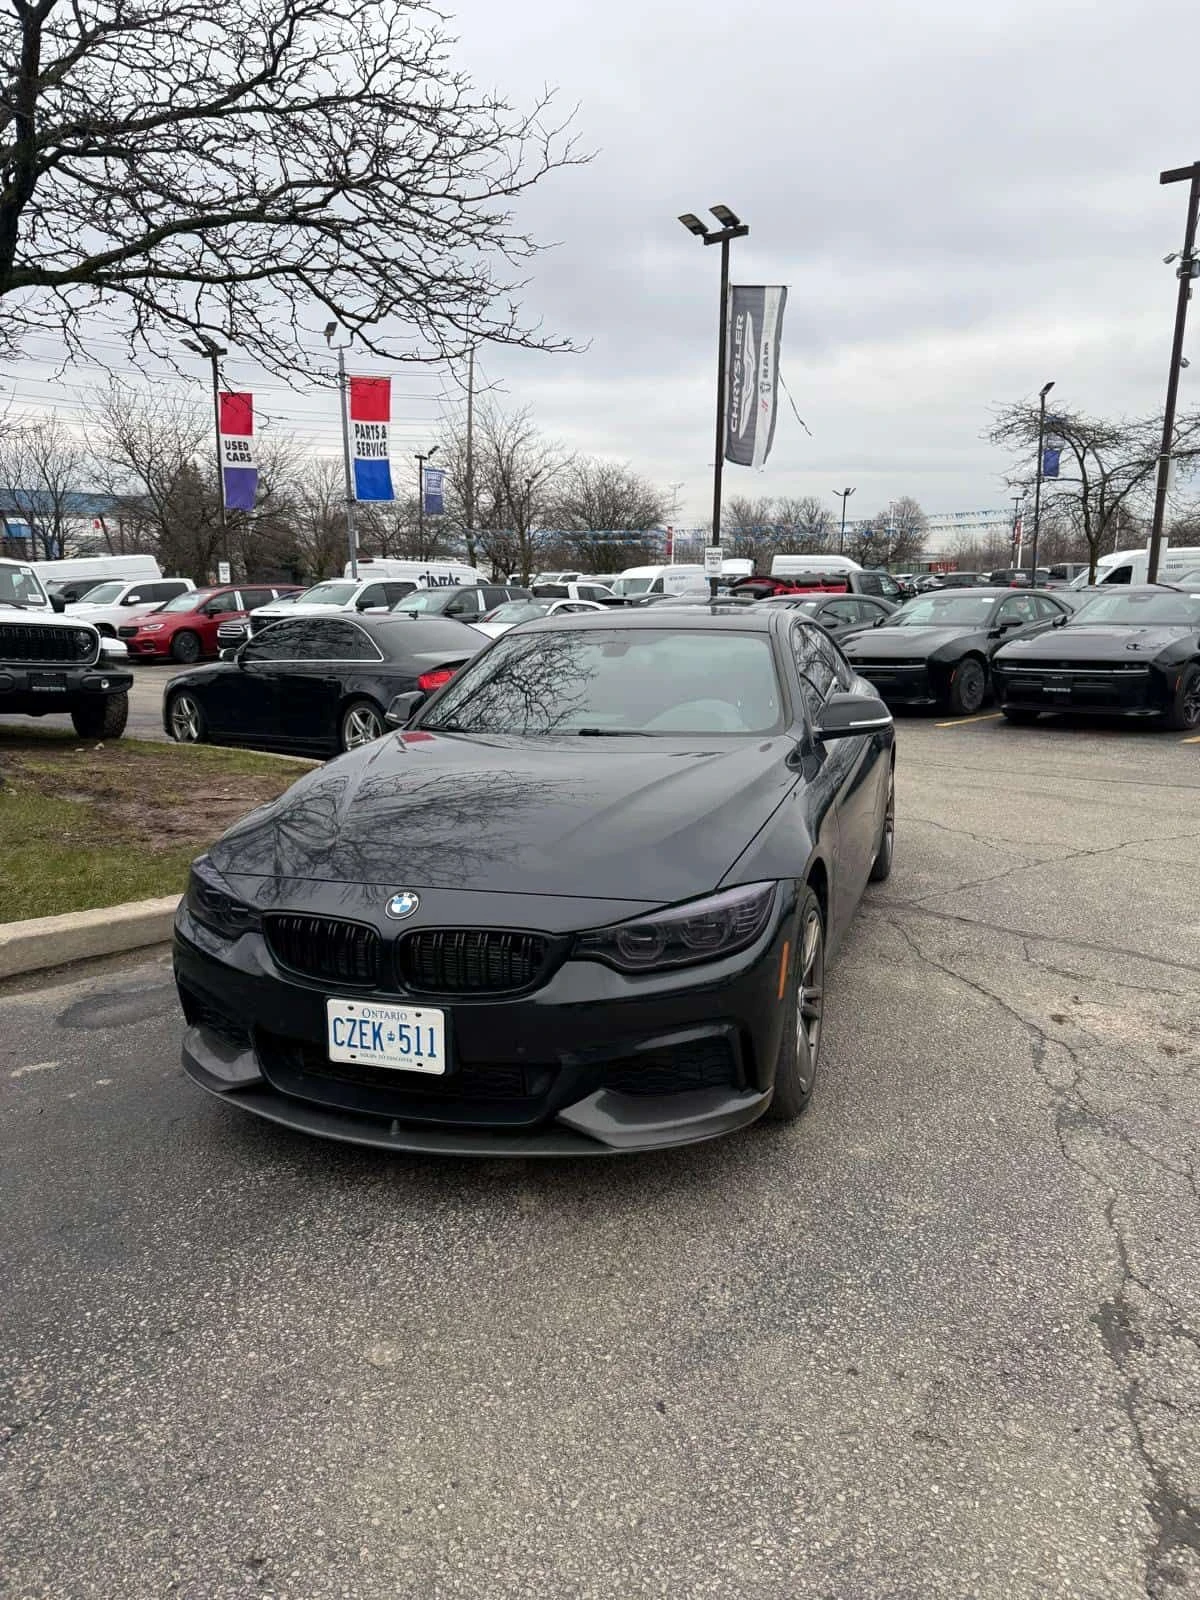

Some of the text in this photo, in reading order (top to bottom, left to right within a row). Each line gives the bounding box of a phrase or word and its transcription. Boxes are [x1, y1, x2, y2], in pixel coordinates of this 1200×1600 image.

[730, 312, 744, 433] CHRYSLER
[355, 423, 387, 440] PARTS &
[224, 440, 249, 451] USED
[357, 441, 388, 457] SERVICE
[226, 452, 252, 463] CARS
[362, 1007, 408, 1021] ONTARIO
[333, 1017, 437, 1058] CZEK 511
